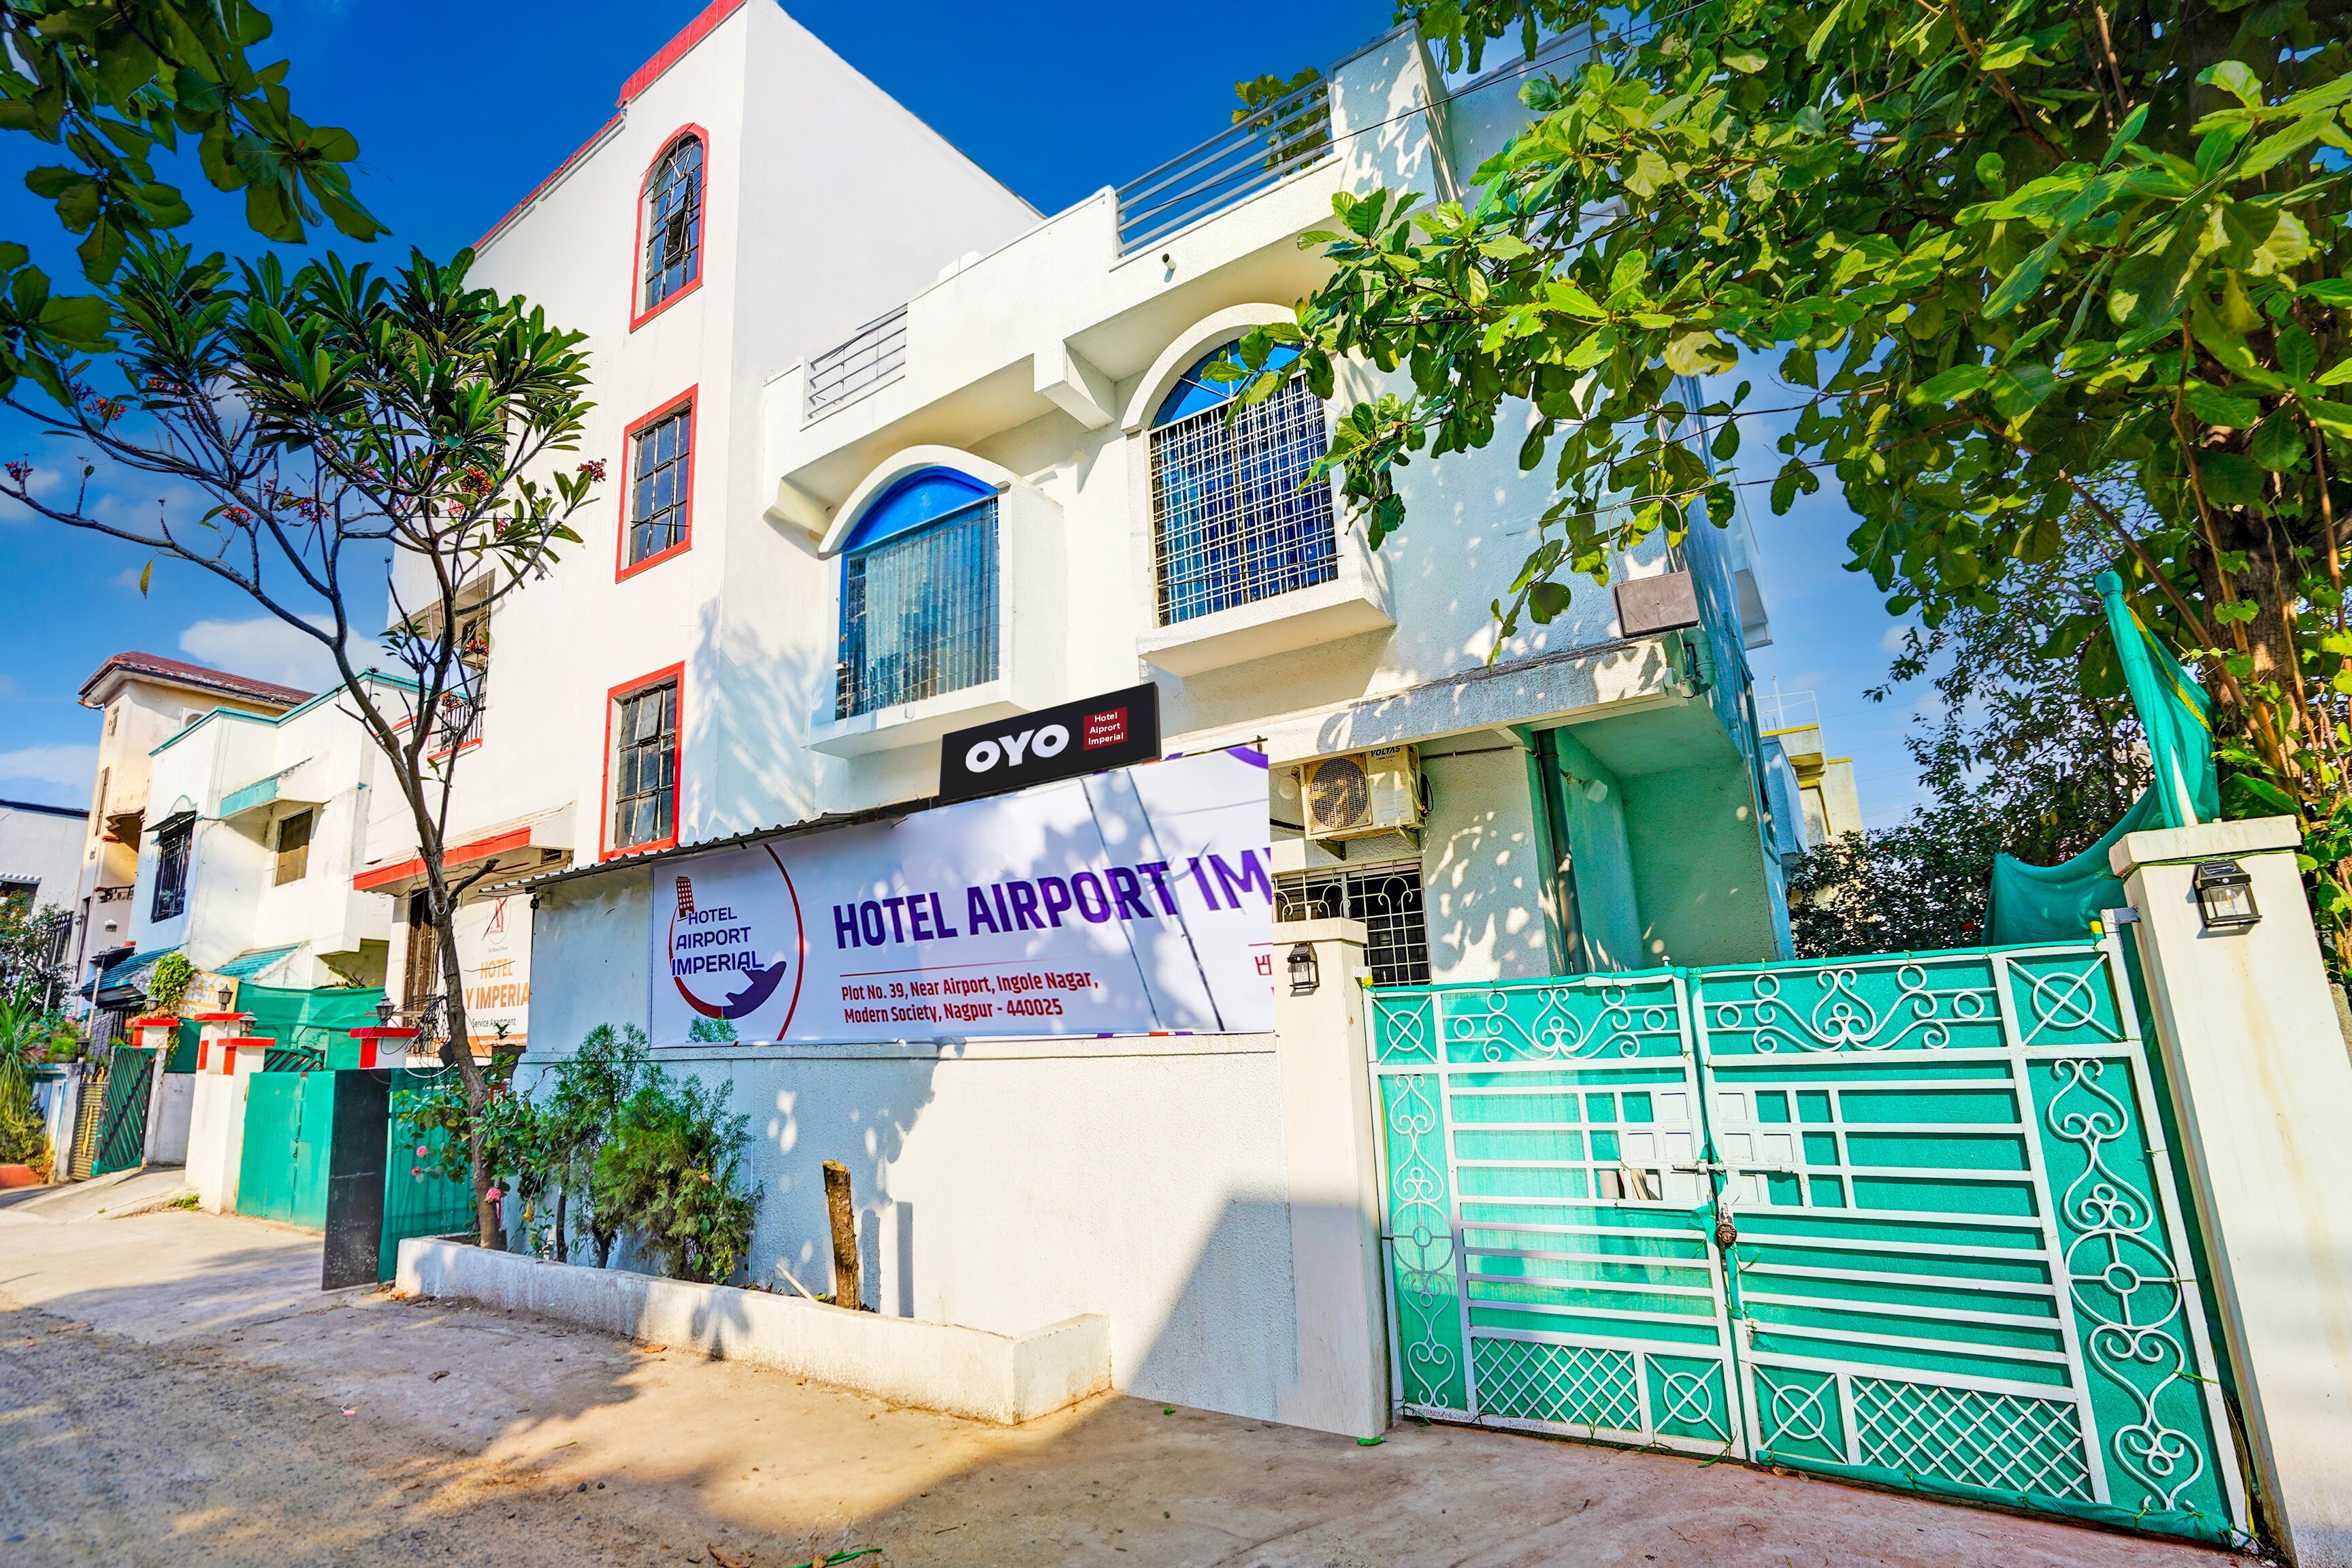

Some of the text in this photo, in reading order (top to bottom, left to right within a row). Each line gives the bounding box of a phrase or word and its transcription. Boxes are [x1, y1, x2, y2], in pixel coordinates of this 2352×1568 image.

[1094, 711, 1117, 722] Hotel
[1088, 732, 1124, 745] Imperial
[1090, 722, 1121, 734] Aiprort
[965, 724, 1069, 773] OYO
[1371, 745, 1401, 757] VOLTAS
[833, 892, 958, 949] HOTEL
[966, 860, 1178, 936] AIRPORT
[688, 906, 738, 926] HOTEL
[675, 926, 752, 951] AIRPORT
[480, 958, 513, 980] HOTEL
[672, 950, 765, 977] IMPERIAL
[841, 985, 866, 1001] Plot
[867, 984, 887, 1000] No.
[889, 982, 909, 1000] 39,
[910, 981, 940, 997] Near
[943, 976, 996, 997] Airport,
[996, 973, 1043, 994] Ingole
[844, 1007, 889, 1024] Modern
[891, 1004, 942, 1023] Society,
[943, 1002, 993, 1022] Nagpur
[1007, 998, 1064, 1016] 440025
[472, 1017, 517, 1029] Service Apartment
